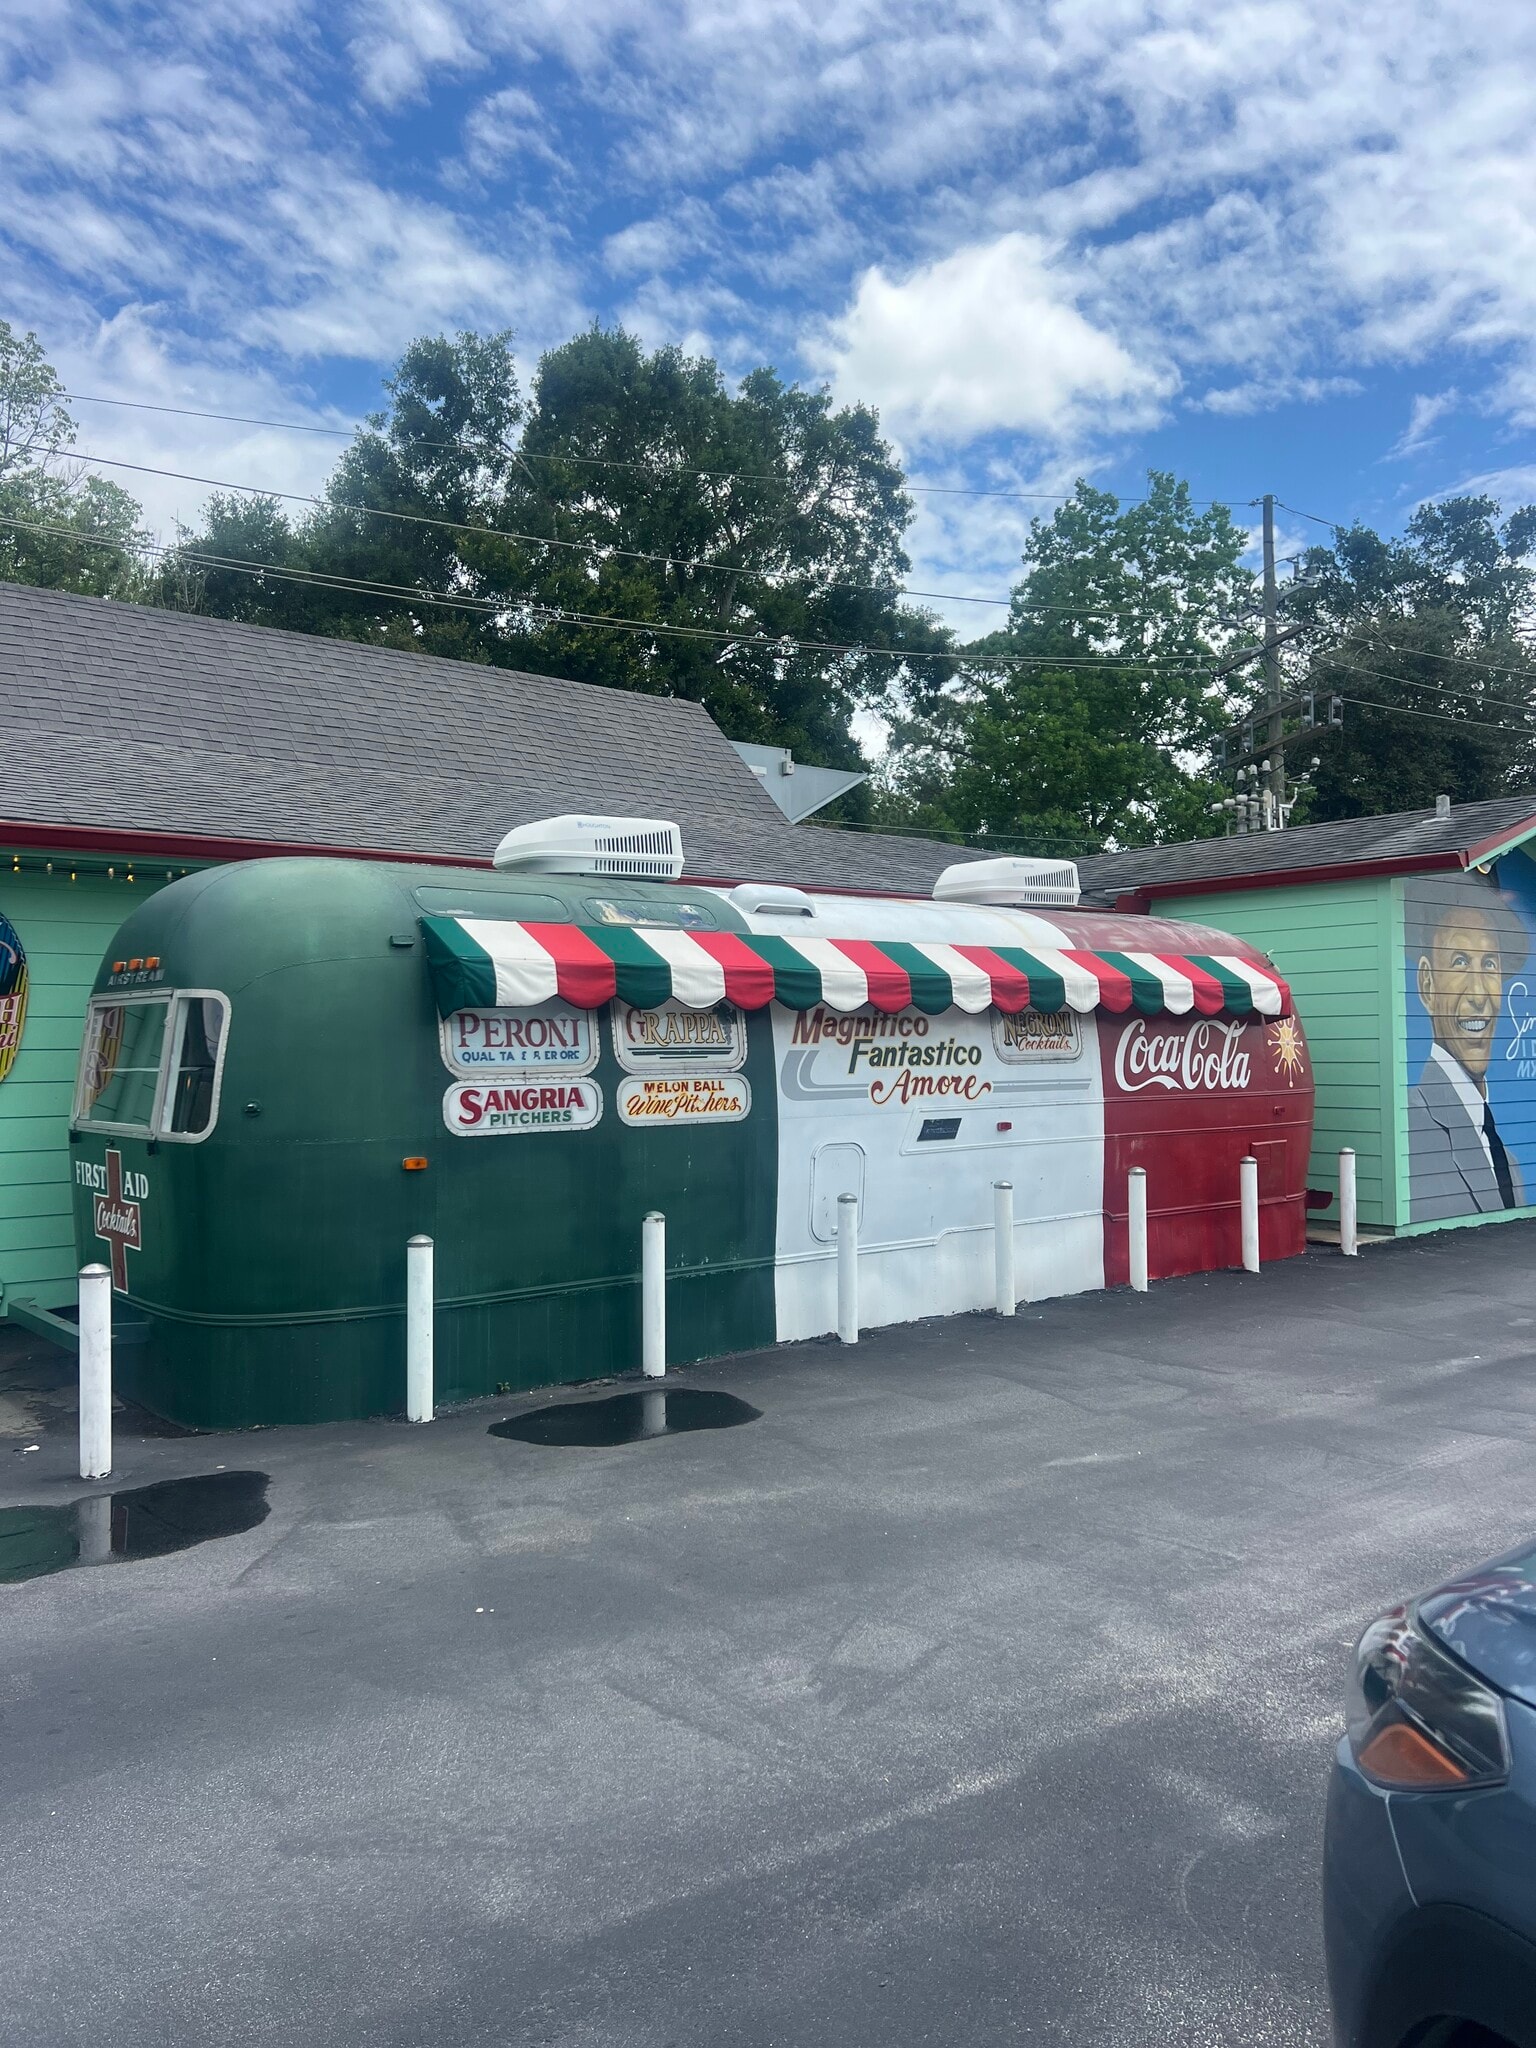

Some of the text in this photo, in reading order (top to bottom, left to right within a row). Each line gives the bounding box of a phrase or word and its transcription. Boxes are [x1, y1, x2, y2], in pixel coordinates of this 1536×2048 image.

[107, 969, 165, 986] AIRSTREAM
[457, 1013, 581, 1048] PERONI
[626, 1007, 726, 1047] GRAPPA
[792, 1006, 929, 1045] Magnifico
[1001, 1010, 1073, 1046] NEGRONI
[1019, 1034, 1072, 1052] Cocktails
[848, 1038, 982, 1074] Fantastico
[644, 1080, 725, 1093] MELON BALL
[871, 1068, 992, 1104] Amore
[458, 1087, 585, 1125] SANGRIA
[490, 1110, 572, 1126] PITCHERS
[627, 1095, 672, 1116] Wine
[75, 1160, 149, 1199] FIRST AID
[97, 1201, 137, 1237] Cocktails
